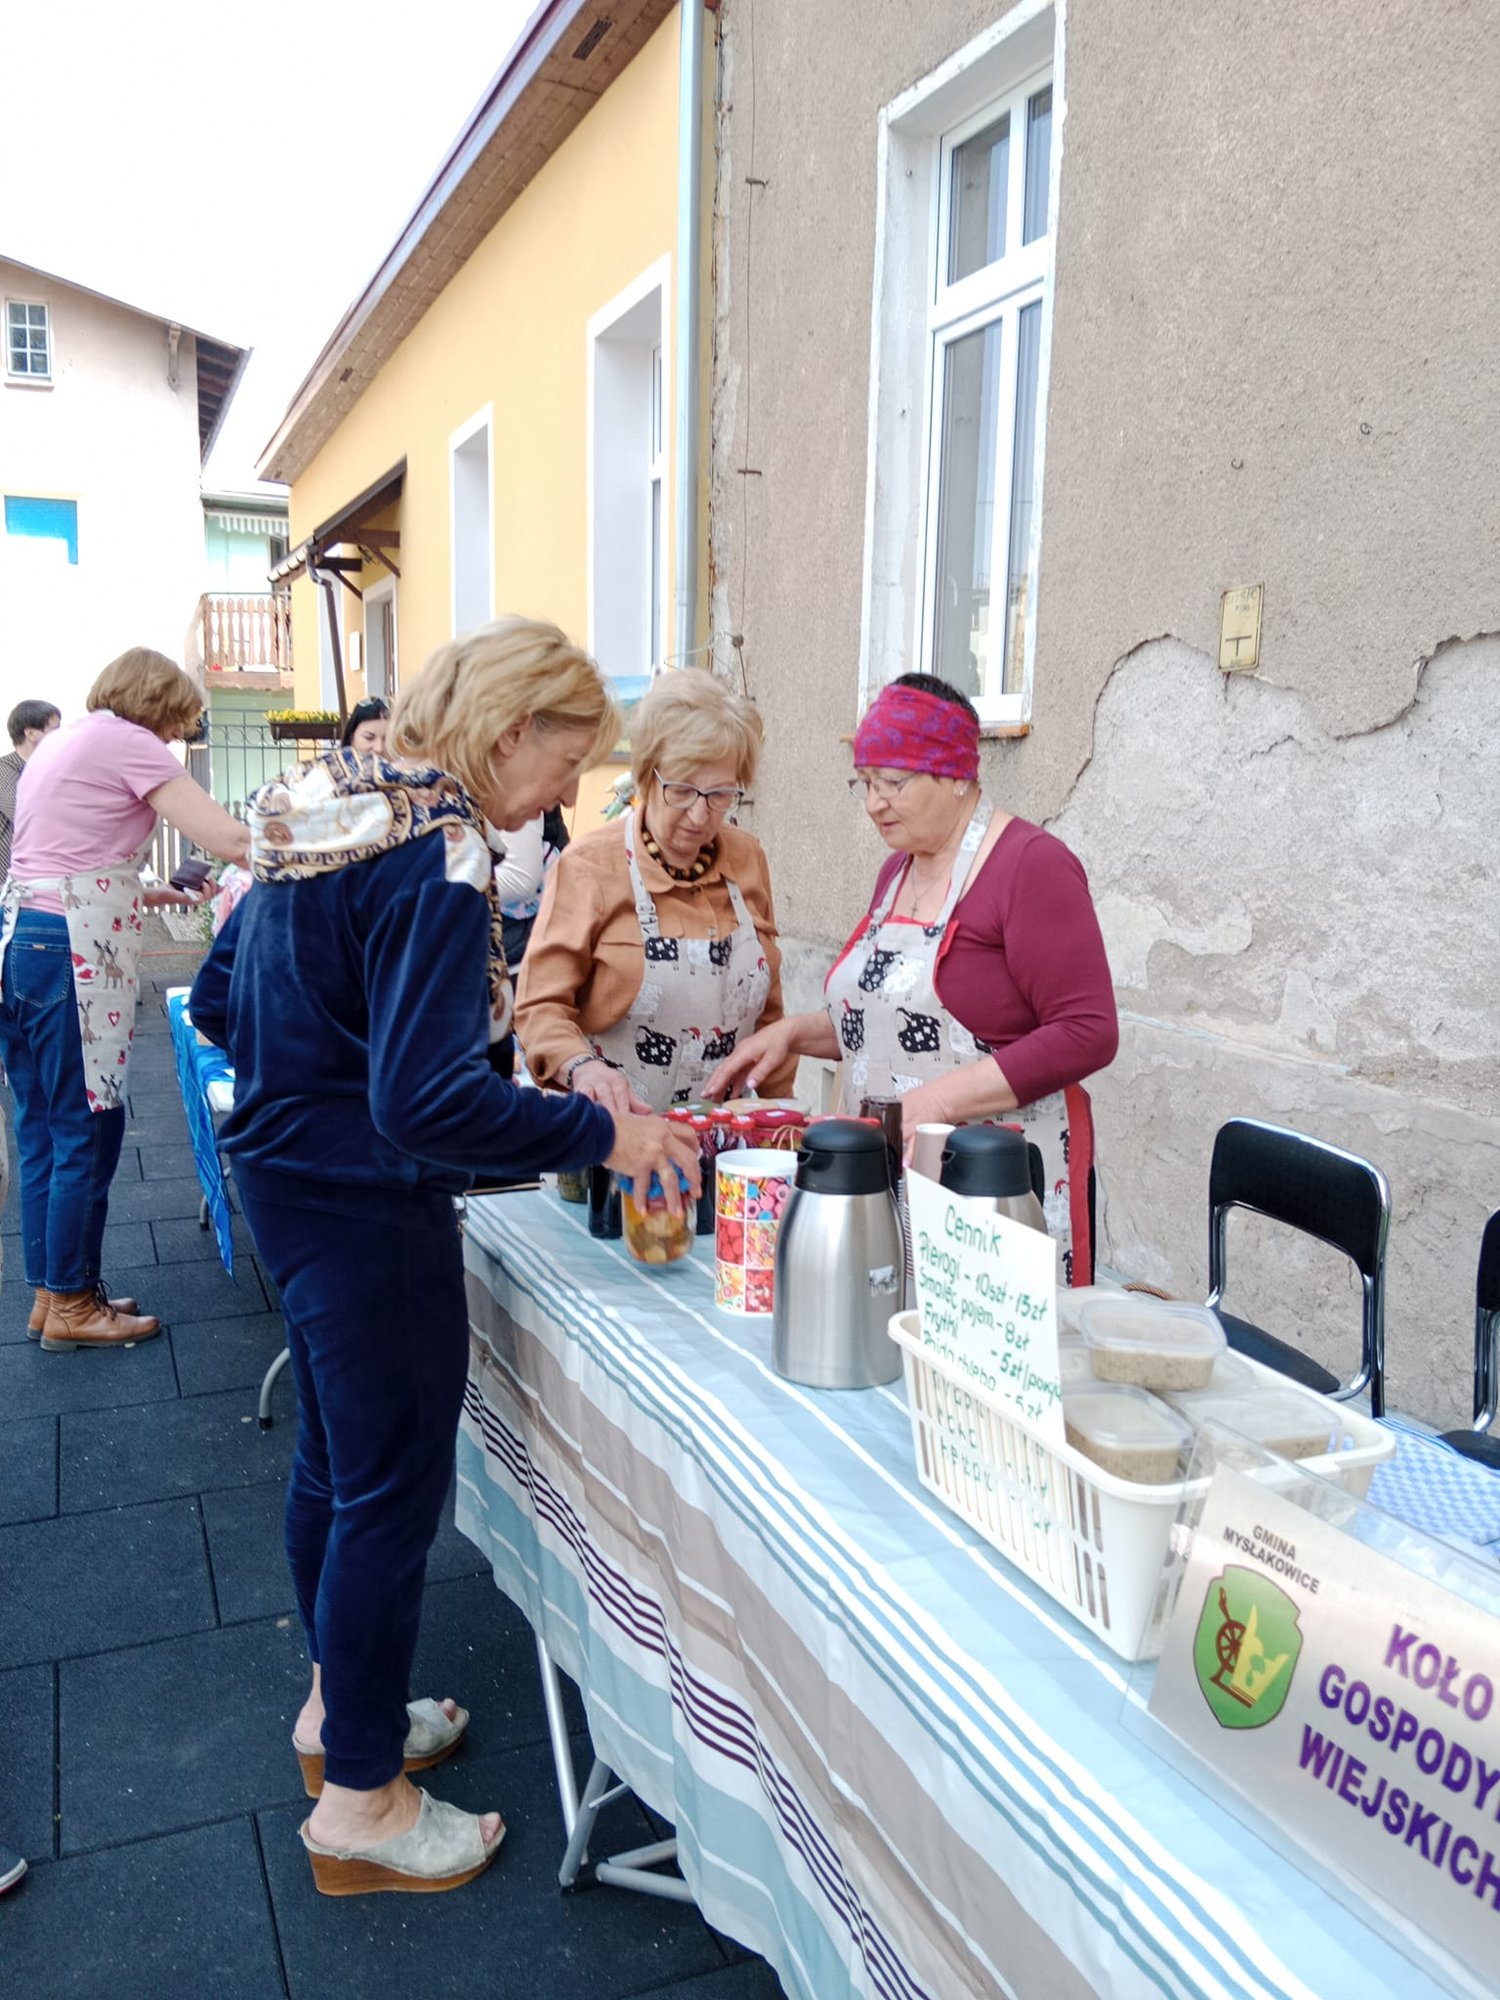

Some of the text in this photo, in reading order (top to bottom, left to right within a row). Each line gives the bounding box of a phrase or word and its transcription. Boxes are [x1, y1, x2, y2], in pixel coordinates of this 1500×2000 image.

[945, 1204, 1002, 1257] Cennik
[919, 1231, 961, 1284] Pierogi
[919, 1266, 957, 1309] Smalec
[924, 1301, 959, 1339] Frytki
[1223, 1526, 1320, 1595] MYSŁAKOWICE
[1252, 1524, 1297, 1561] GMINA
[1384, 1623, 1494, 1722] KOŁO
[1318, 1664, 1500, 1824] GOSPODY
[1298, 1724, 1500, 1912] WIEJSKICH
